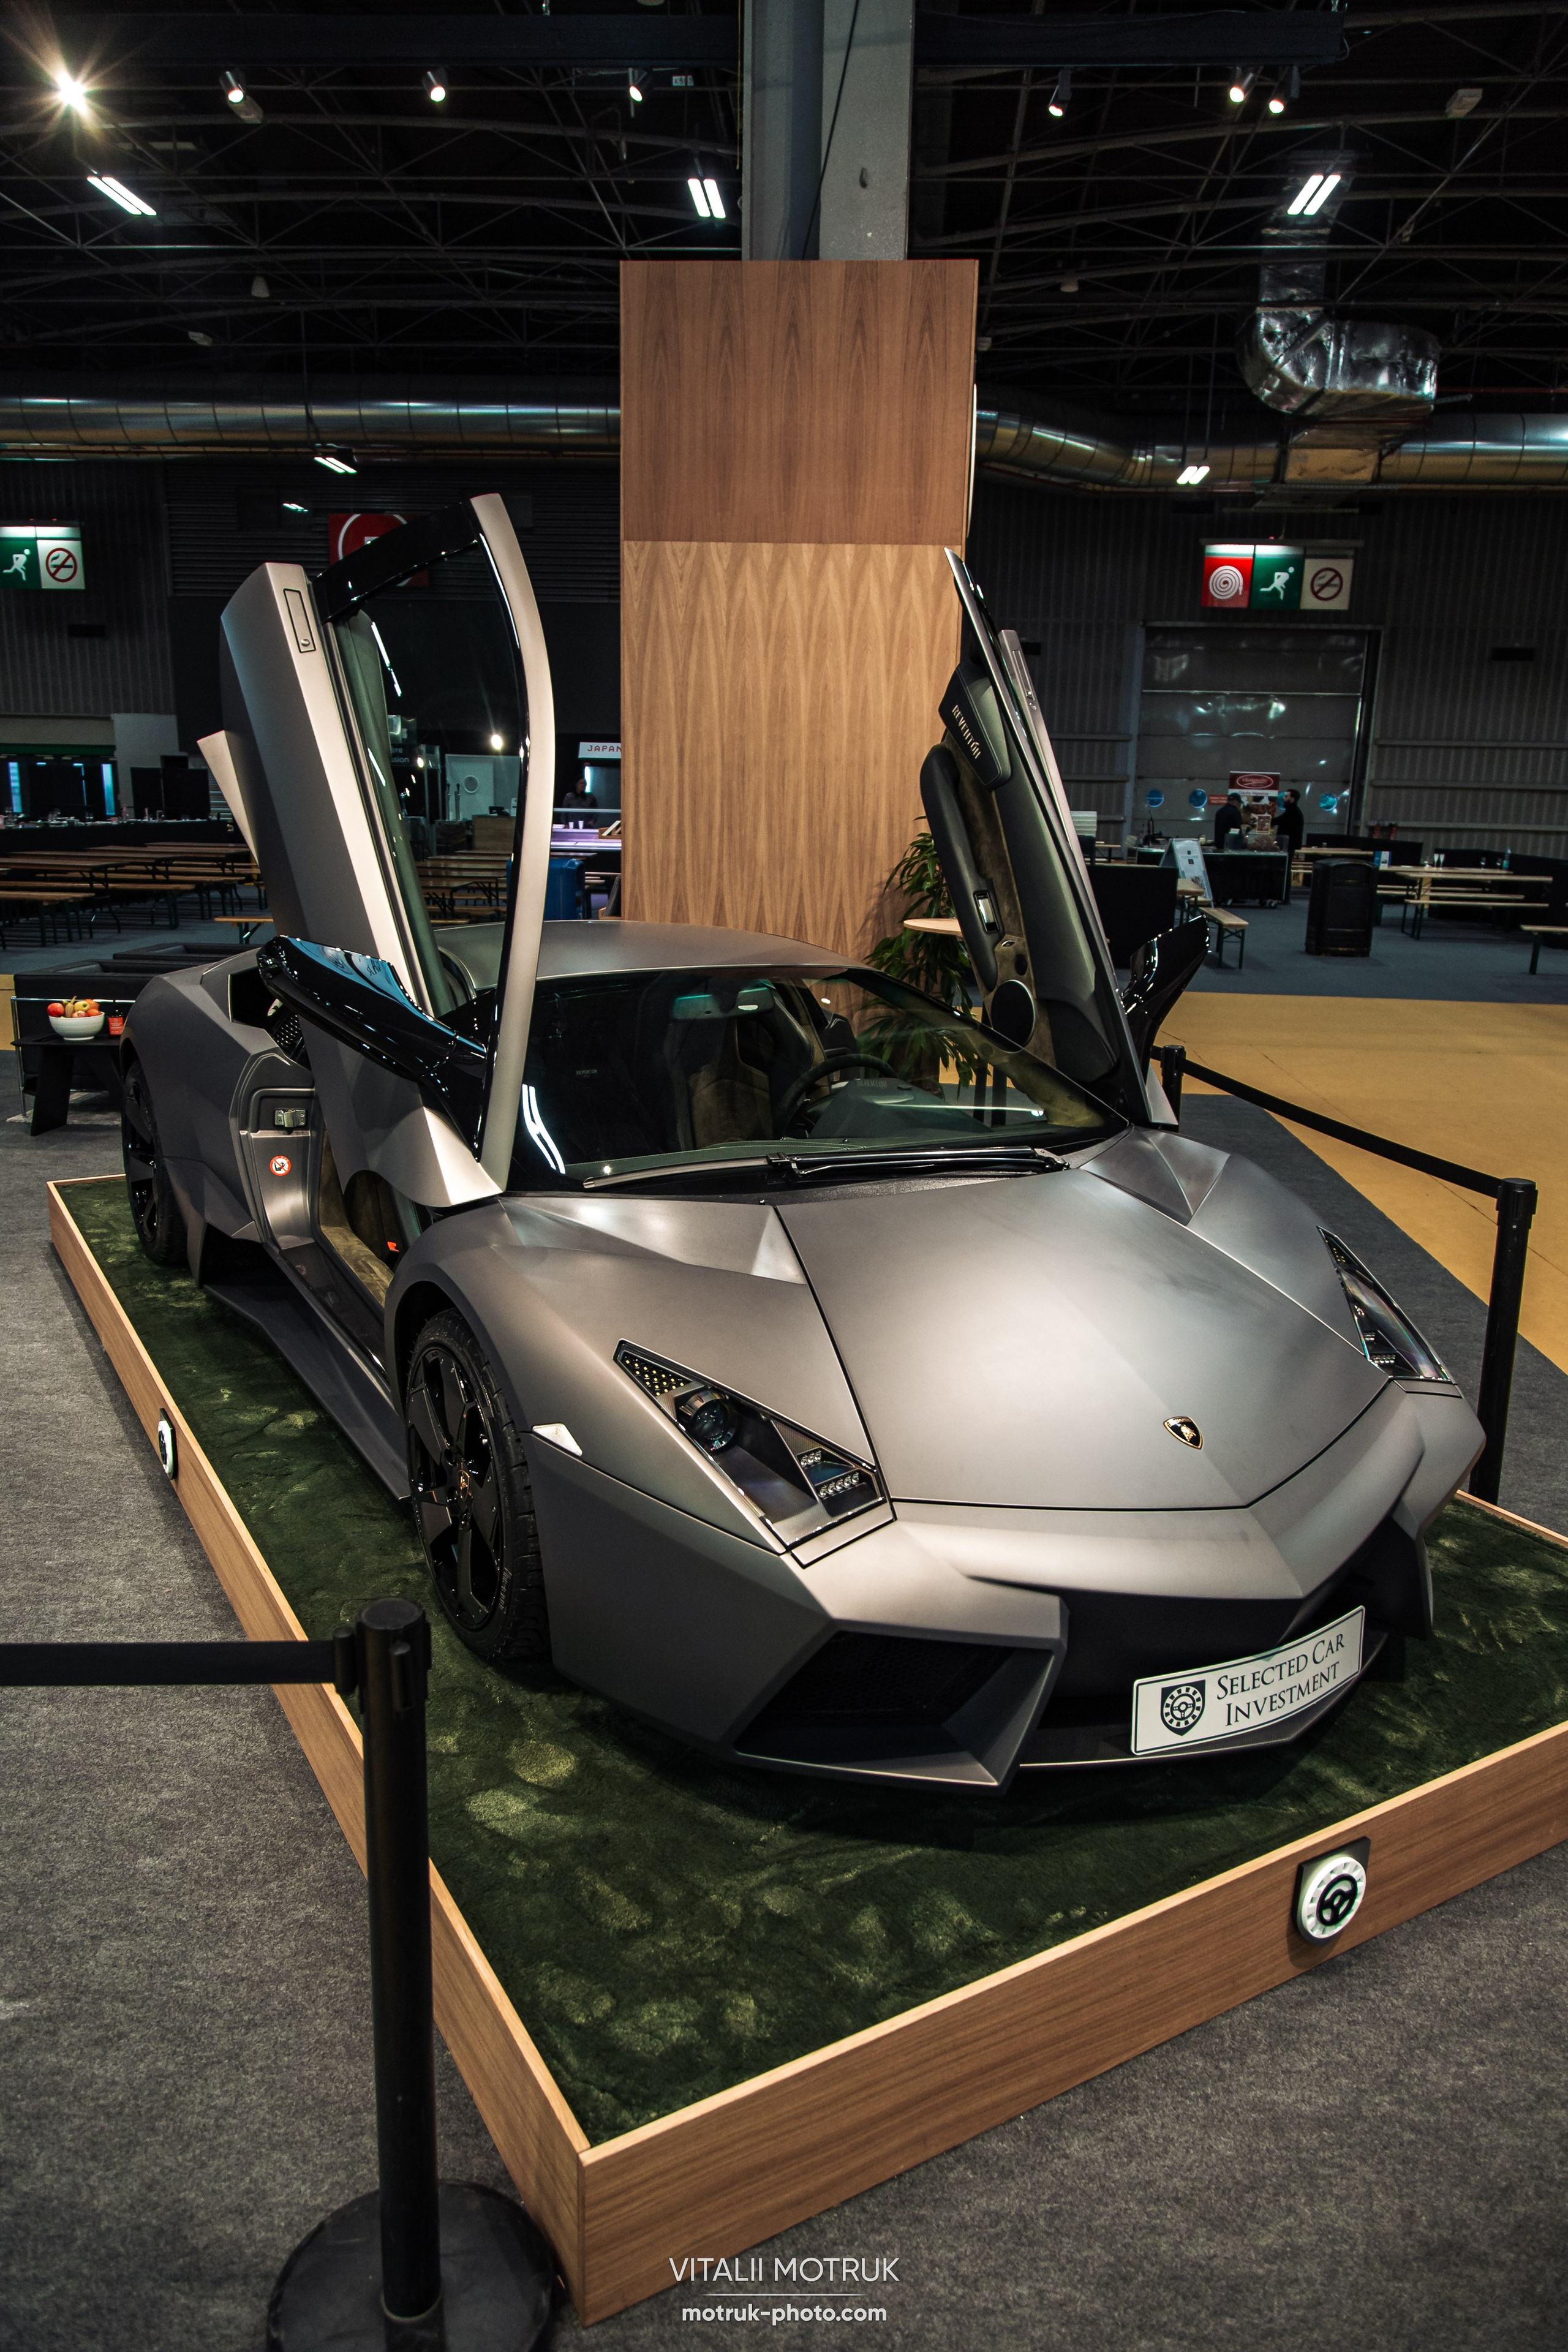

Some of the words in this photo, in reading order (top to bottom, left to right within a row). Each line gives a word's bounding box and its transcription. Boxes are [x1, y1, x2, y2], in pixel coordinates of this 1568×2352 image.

[1216, 1653, 1308, 1700] SELECTED
[1313, 1633, 1345, 1665] CAR
[1225, 1661, 1340, 1727] INVESTMENT
